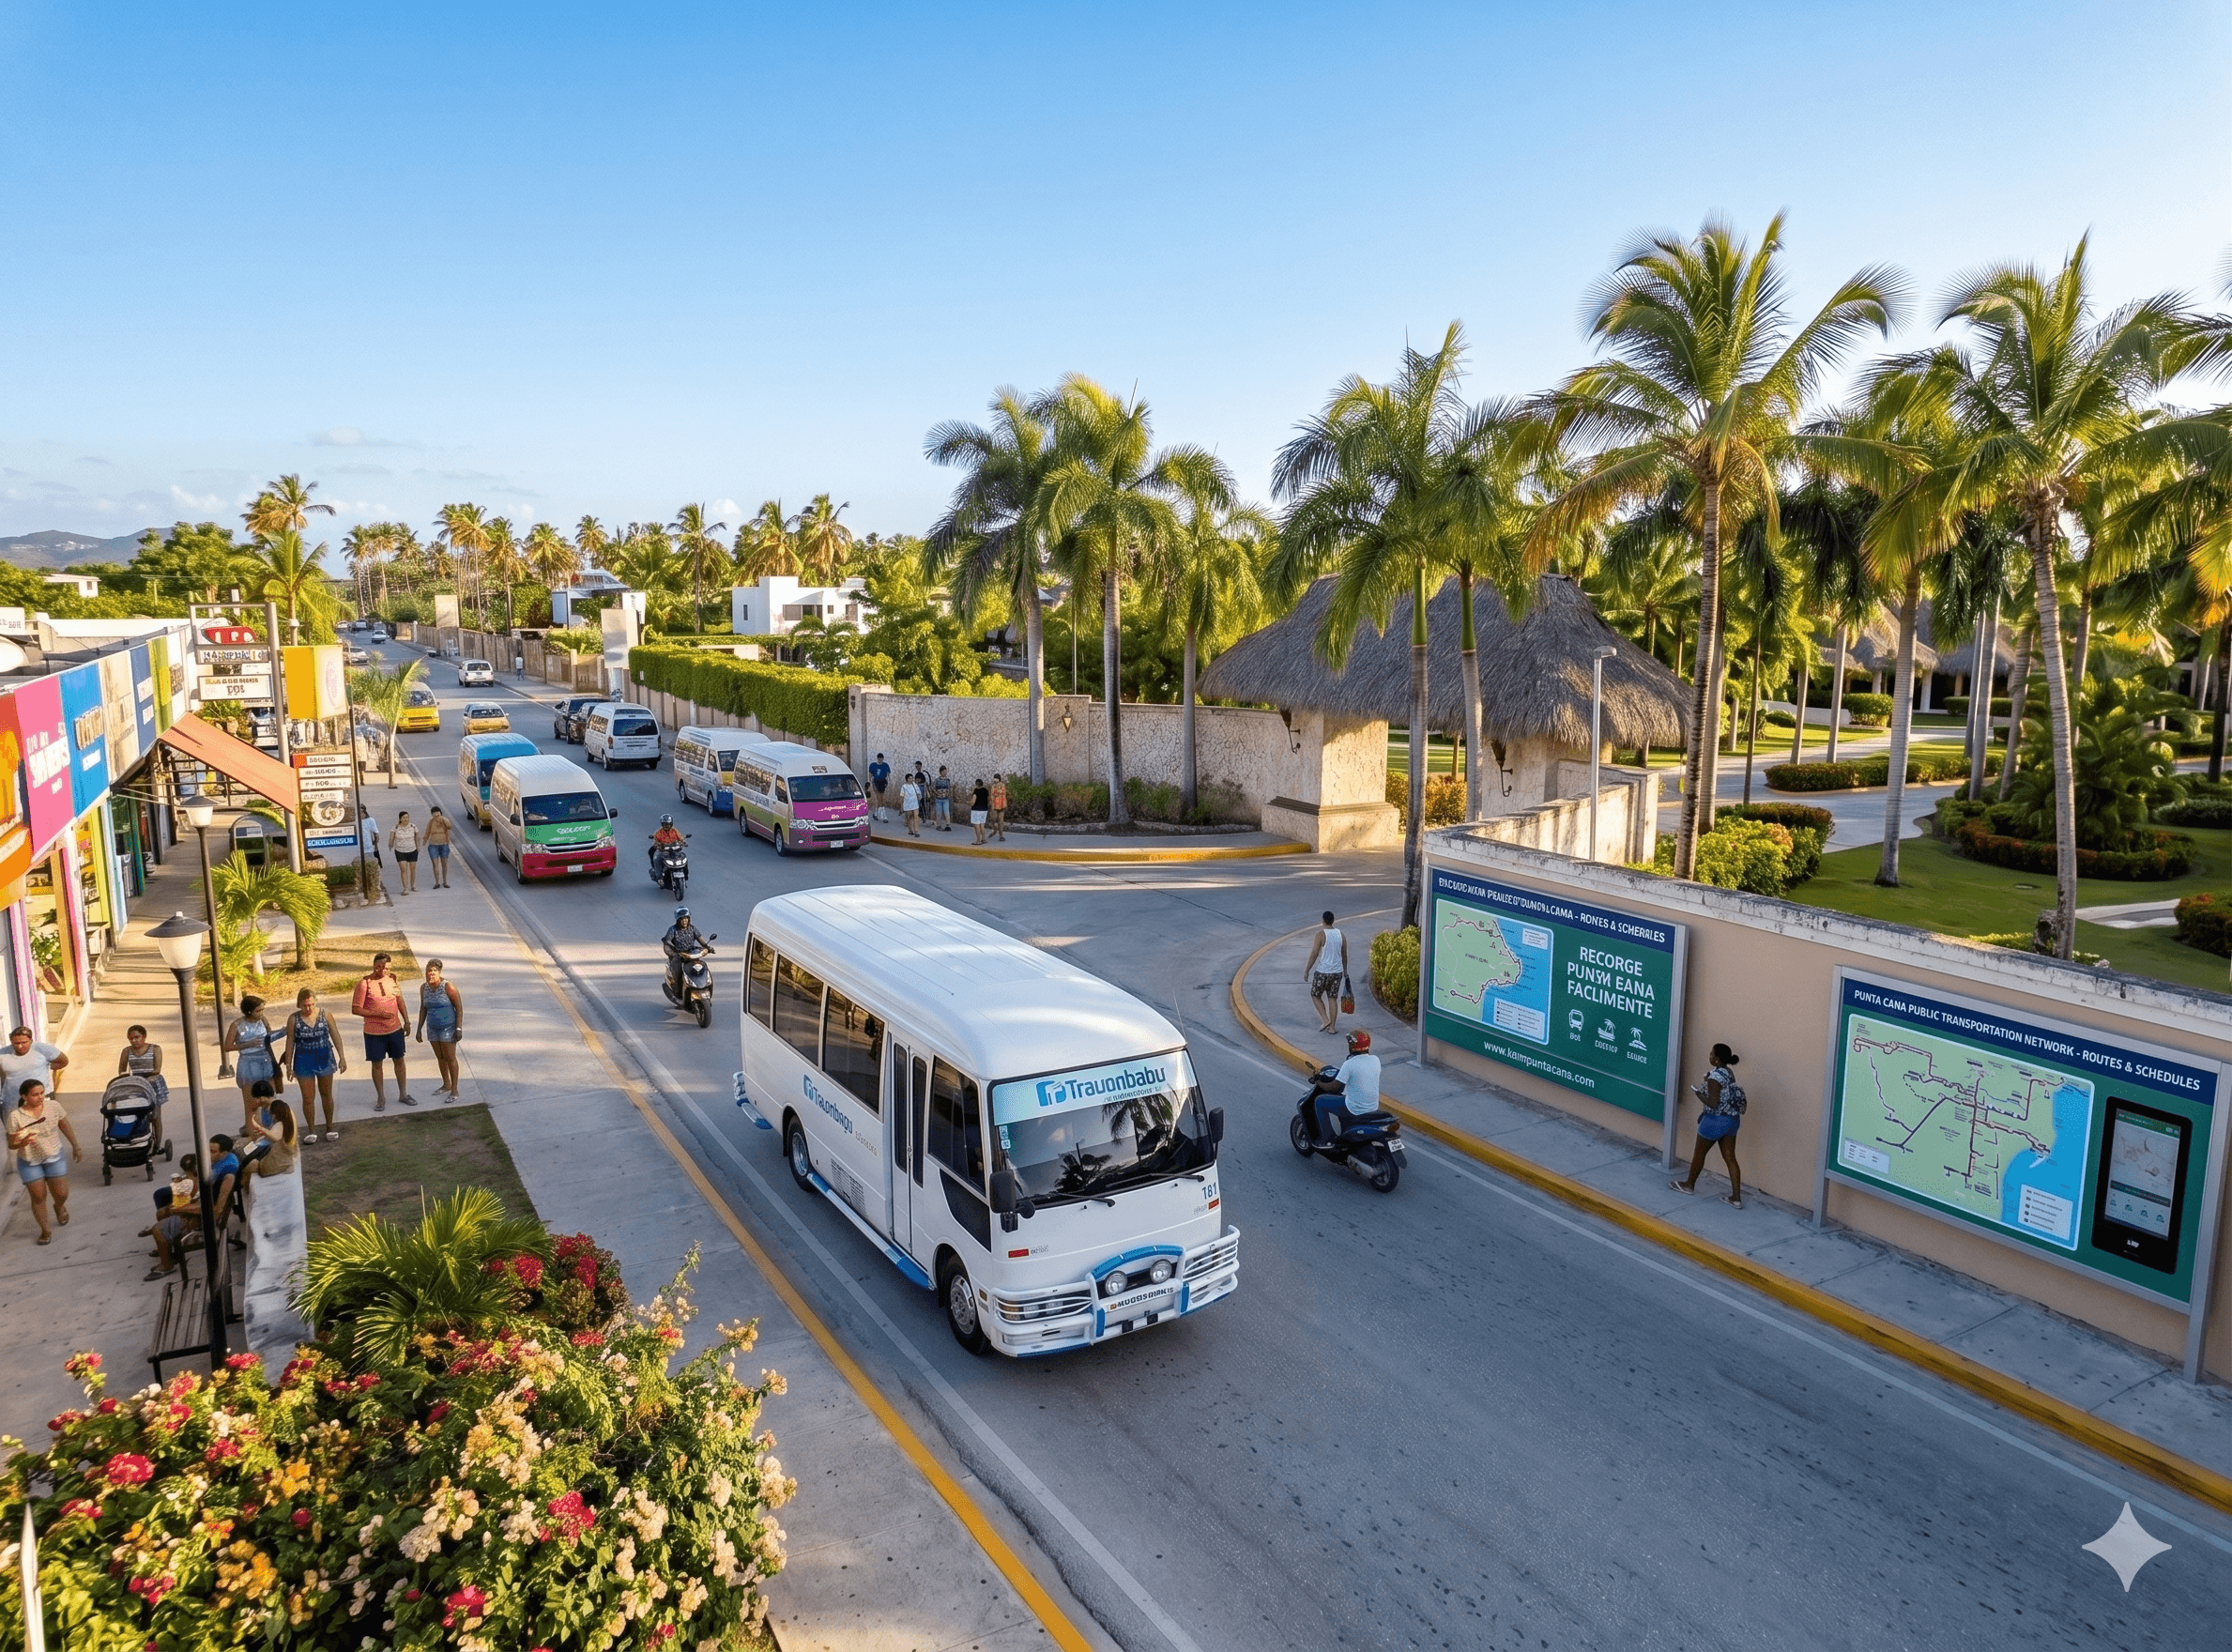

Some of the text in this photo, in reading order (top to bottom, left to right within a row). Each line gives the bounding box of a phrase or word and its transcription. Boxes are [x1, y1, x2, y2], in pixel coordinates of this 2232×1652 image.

[1580, 946, 1643, 977] RECORGE
[1567, 979, 1653, 1018] FACLIMENTE
[1615, 975, 1655, 1001] EANA
[1854, 989, 1881, 1005] PUNTA
[1883, 997, 1906, 1013] CANA
[1908, 1004, 1939, 1020] PUBLIC
[1941, 1012, 2023, 1043] TRANSPORTATION
[2024, 1035, 2074, 1057] NETWORK
[2082, 1049, 2122, 1070] ROUTES
[2124, 1062, 2133, 1073] &
[2134, 1064, 2201, 1091] SCHEDULES
[1201, 1182, 1217, 1200] 181
